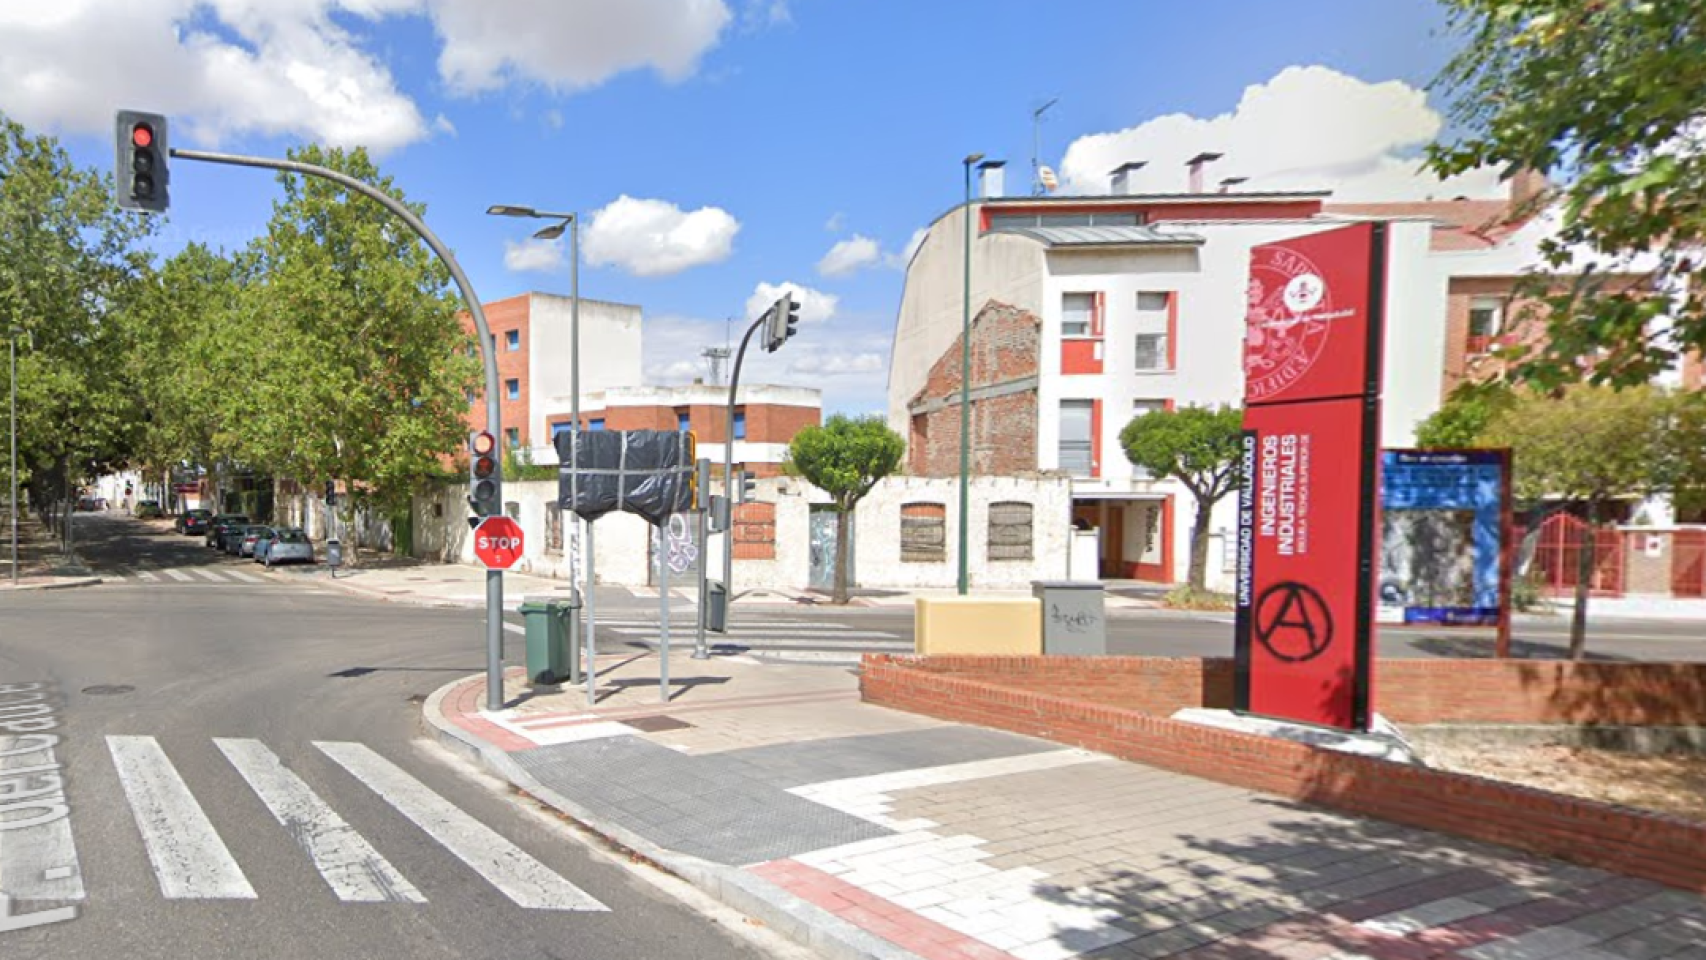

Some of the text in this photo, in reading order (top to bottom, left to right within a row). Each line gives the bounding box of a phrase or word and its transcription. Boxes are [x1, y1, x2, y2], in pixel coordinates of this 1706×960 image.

[1239, 436, 1256, 606] UNIVERSIDAD DE VALLADOLID
[1260, 435, 1278, 536] INGENIEROS
[1277, 434, 1297, 556] INDUSTRIALES
[478, 536, 521, 549] STOP
